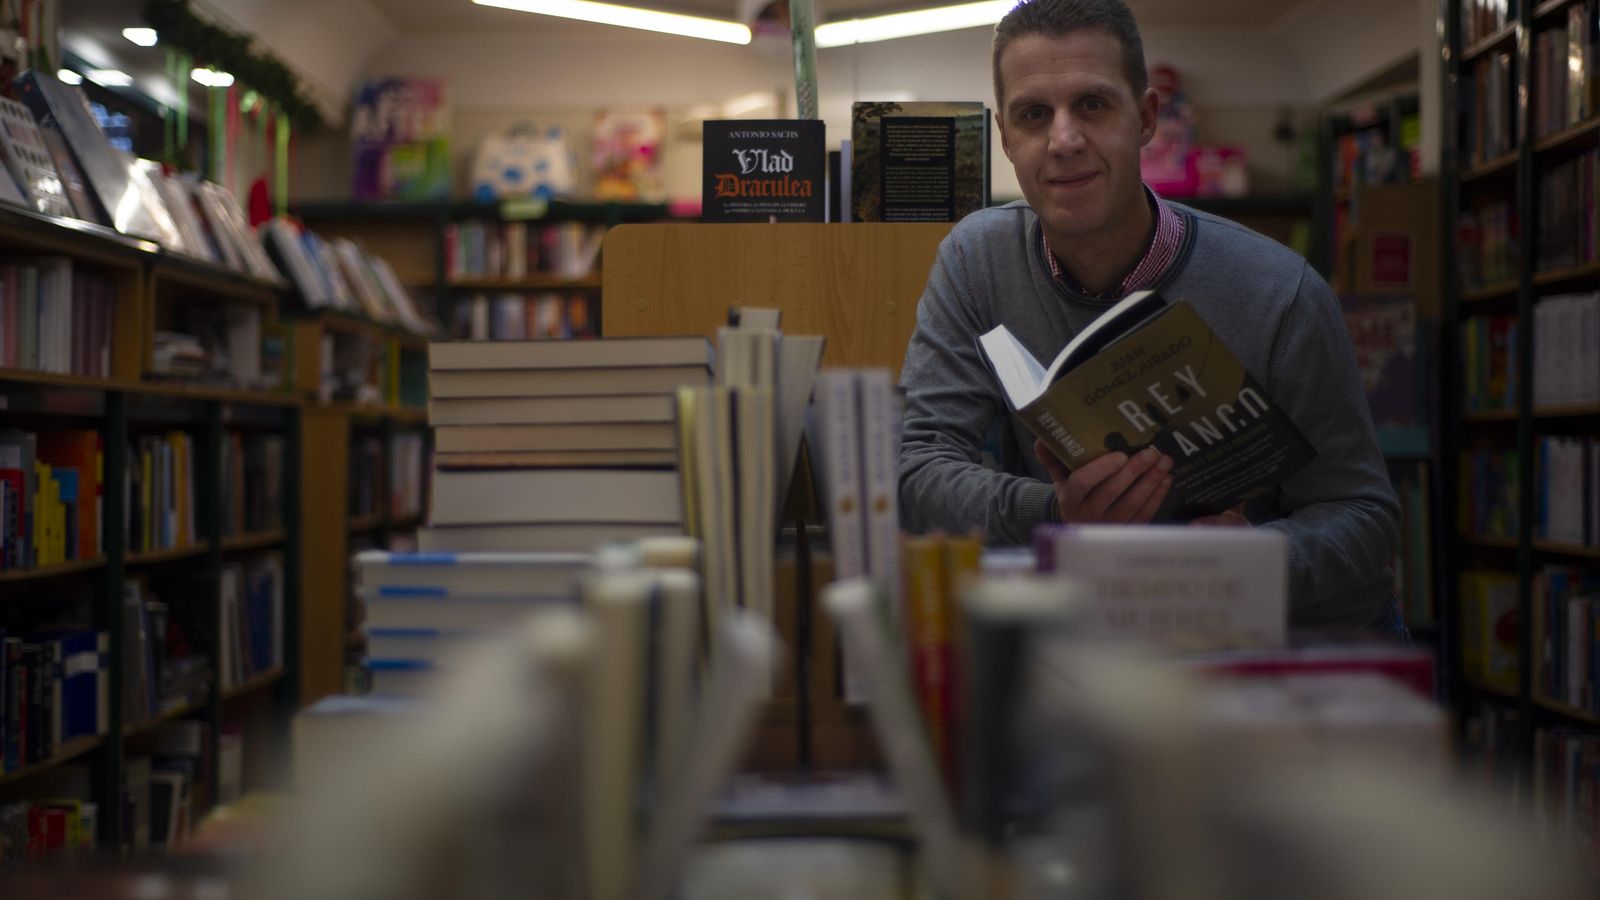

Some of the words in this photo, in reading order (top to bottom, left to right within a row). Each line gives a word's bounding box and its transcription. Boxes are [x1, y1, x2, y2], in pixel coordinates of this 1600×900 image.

[728, 130, 770, 139] ANTONIO
[770, 130, 799, 139] SACHS
[732, 148, 794, 175] Vlad
[714, 172, 813, 200] Draculea
[1110, 345, 1145, 372] JUAN
[1116, 364, 1208, 433] REY
[1036, 411, 1058, 429] REY
[1050, 426, 1086, 458] BLANCO
